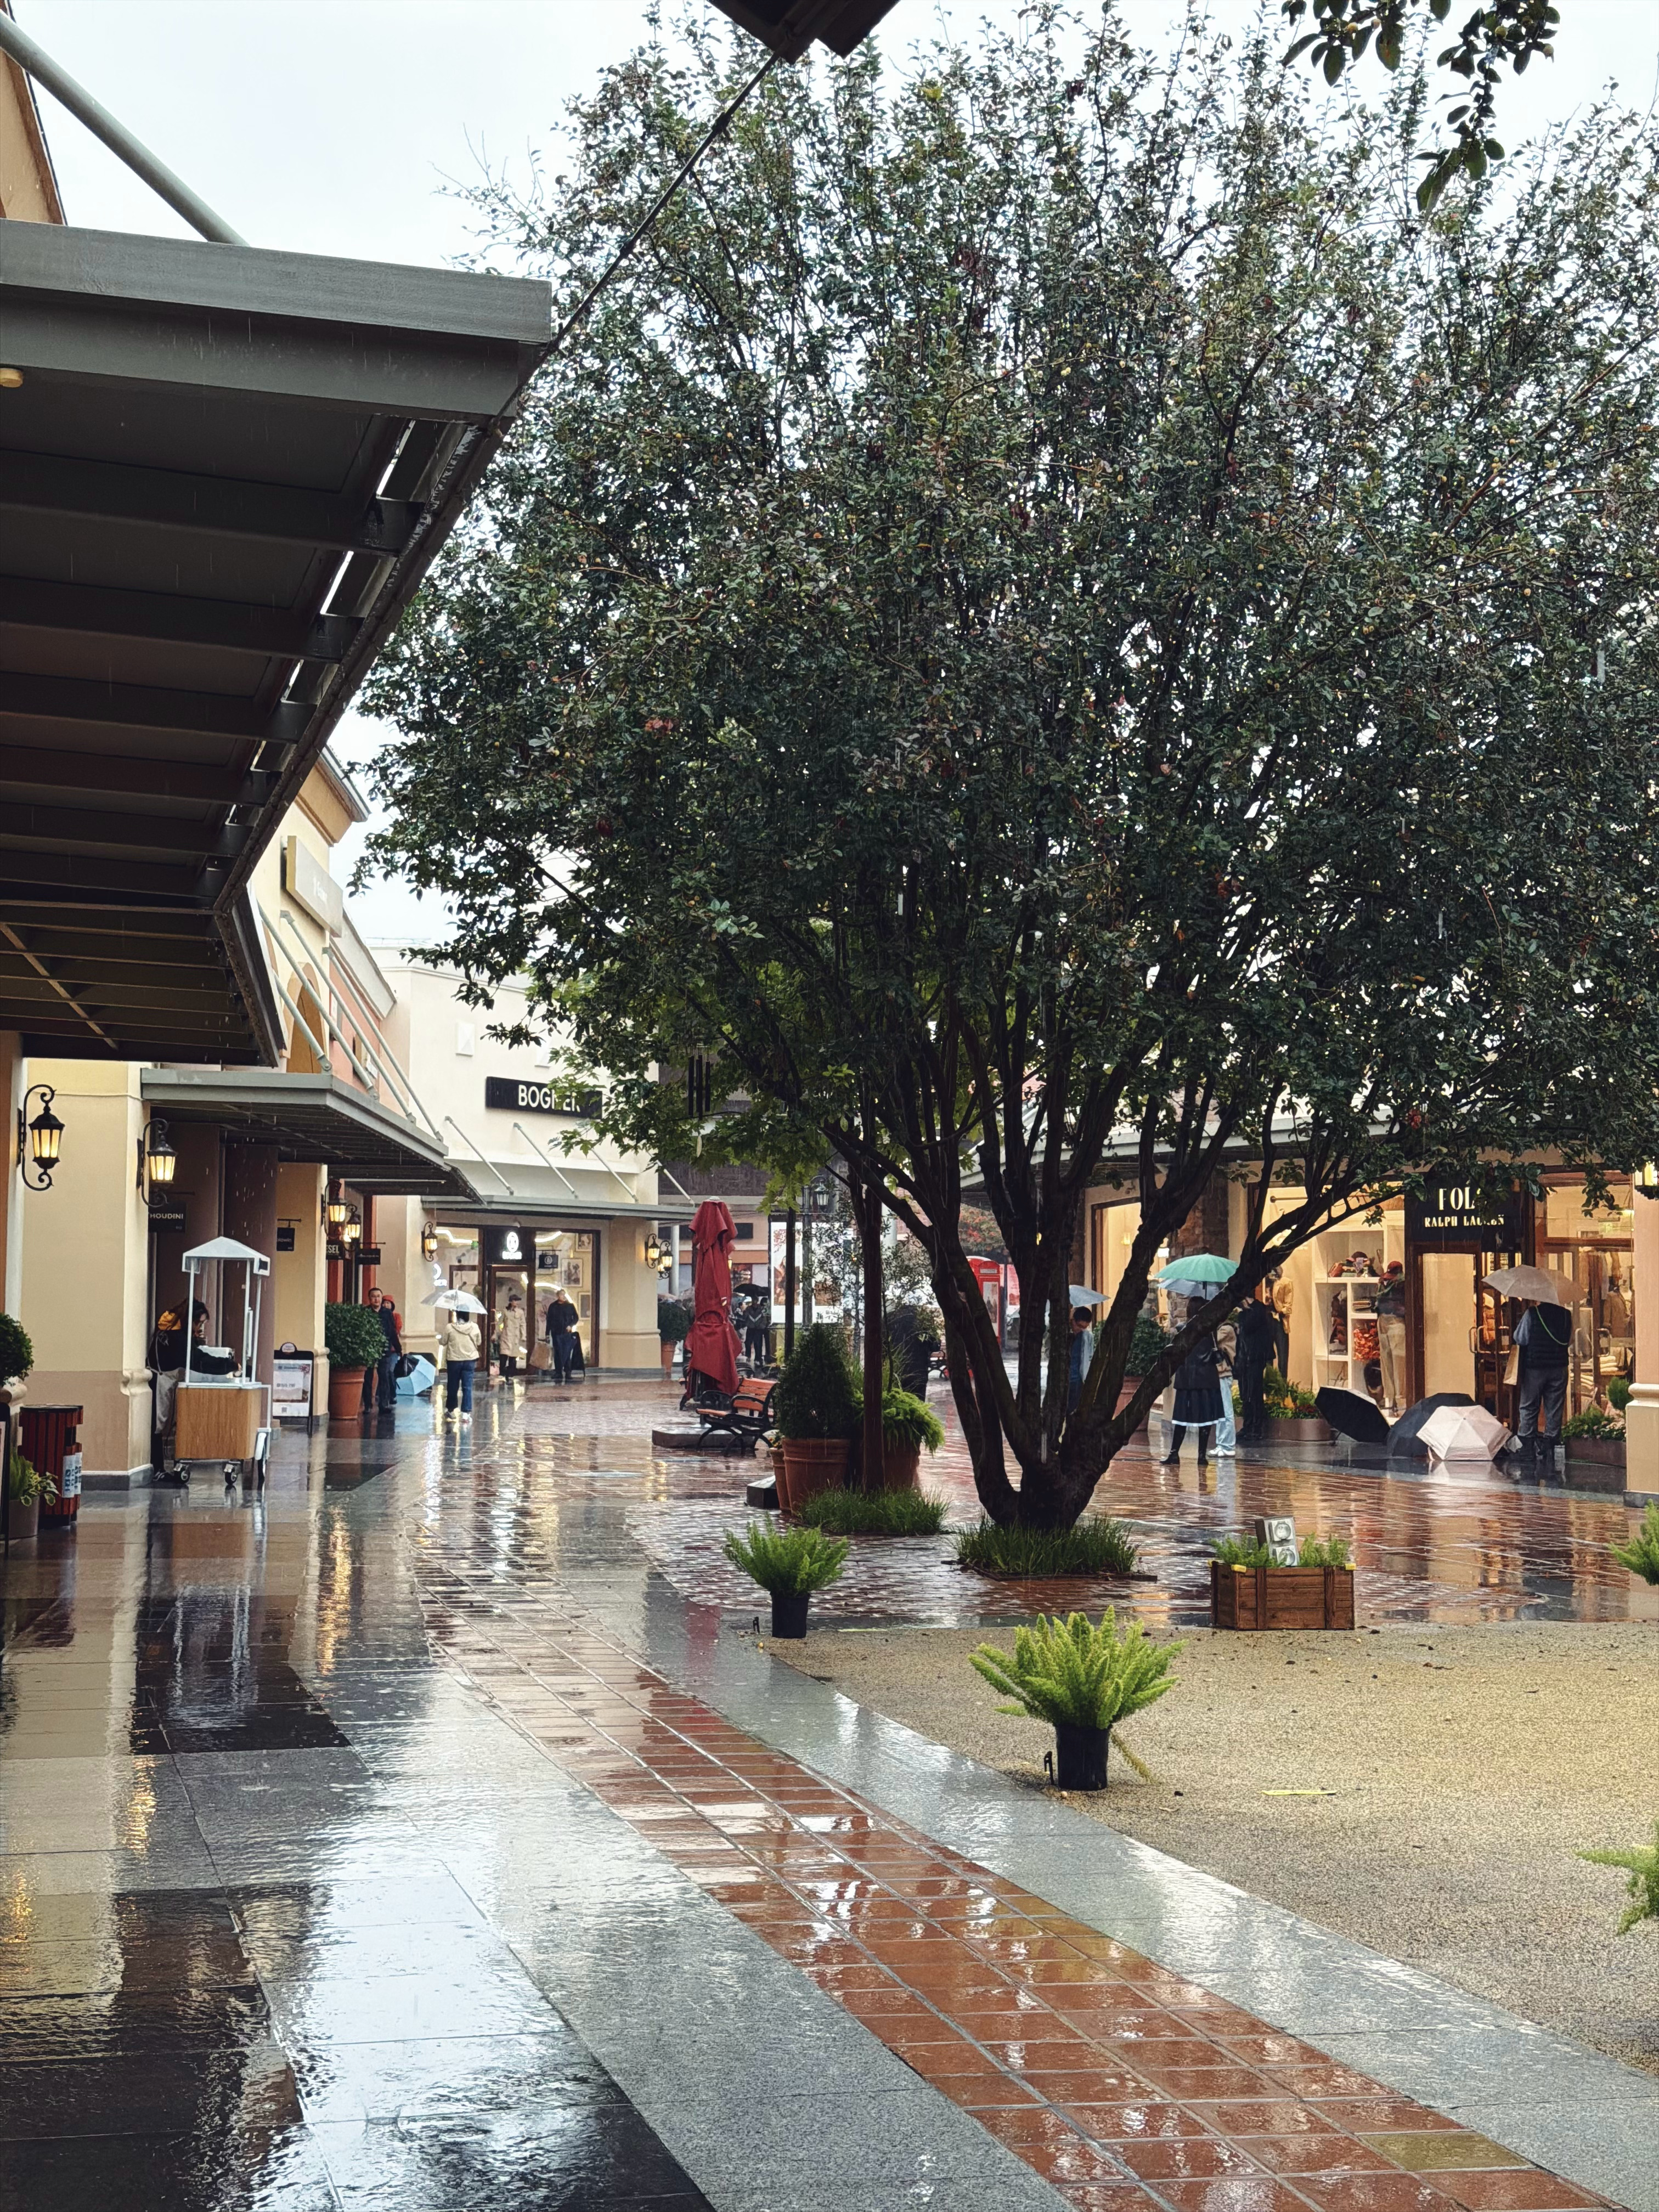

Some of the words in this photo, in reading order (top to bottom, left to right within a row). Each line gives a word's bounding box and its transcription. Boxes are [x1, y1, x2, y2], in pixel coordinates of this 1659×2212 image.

[1439, 1187, 1481, 1210] OL
[1425, 1216, 1457, 1227] RALPH
[1464, 1214, 1504, 1226] LAUN
